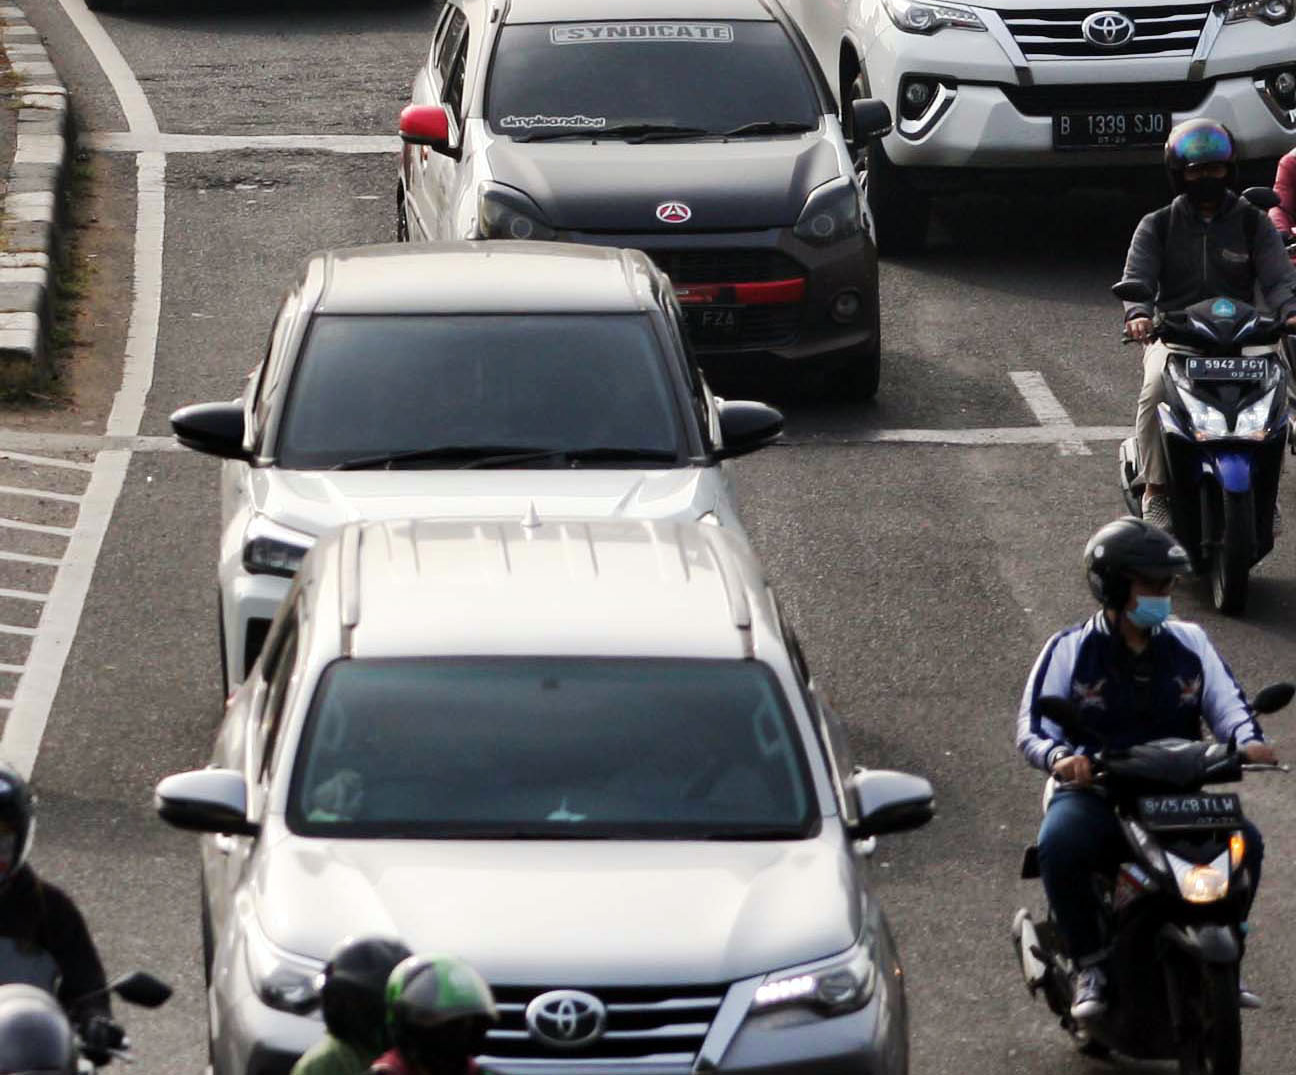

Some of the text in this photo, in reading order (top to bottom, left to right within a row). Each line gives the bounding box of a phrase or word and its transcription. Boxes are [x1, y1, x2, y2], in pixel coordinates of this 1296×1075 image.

[567, 25, 728, 41] SYNDICATE
[1060, 116, 1070, 135] B
[1088, 115, 1125, 135] 1339
[1189, 359, 1197, 368] B
[1205, 359, 1235, 369] 5942
